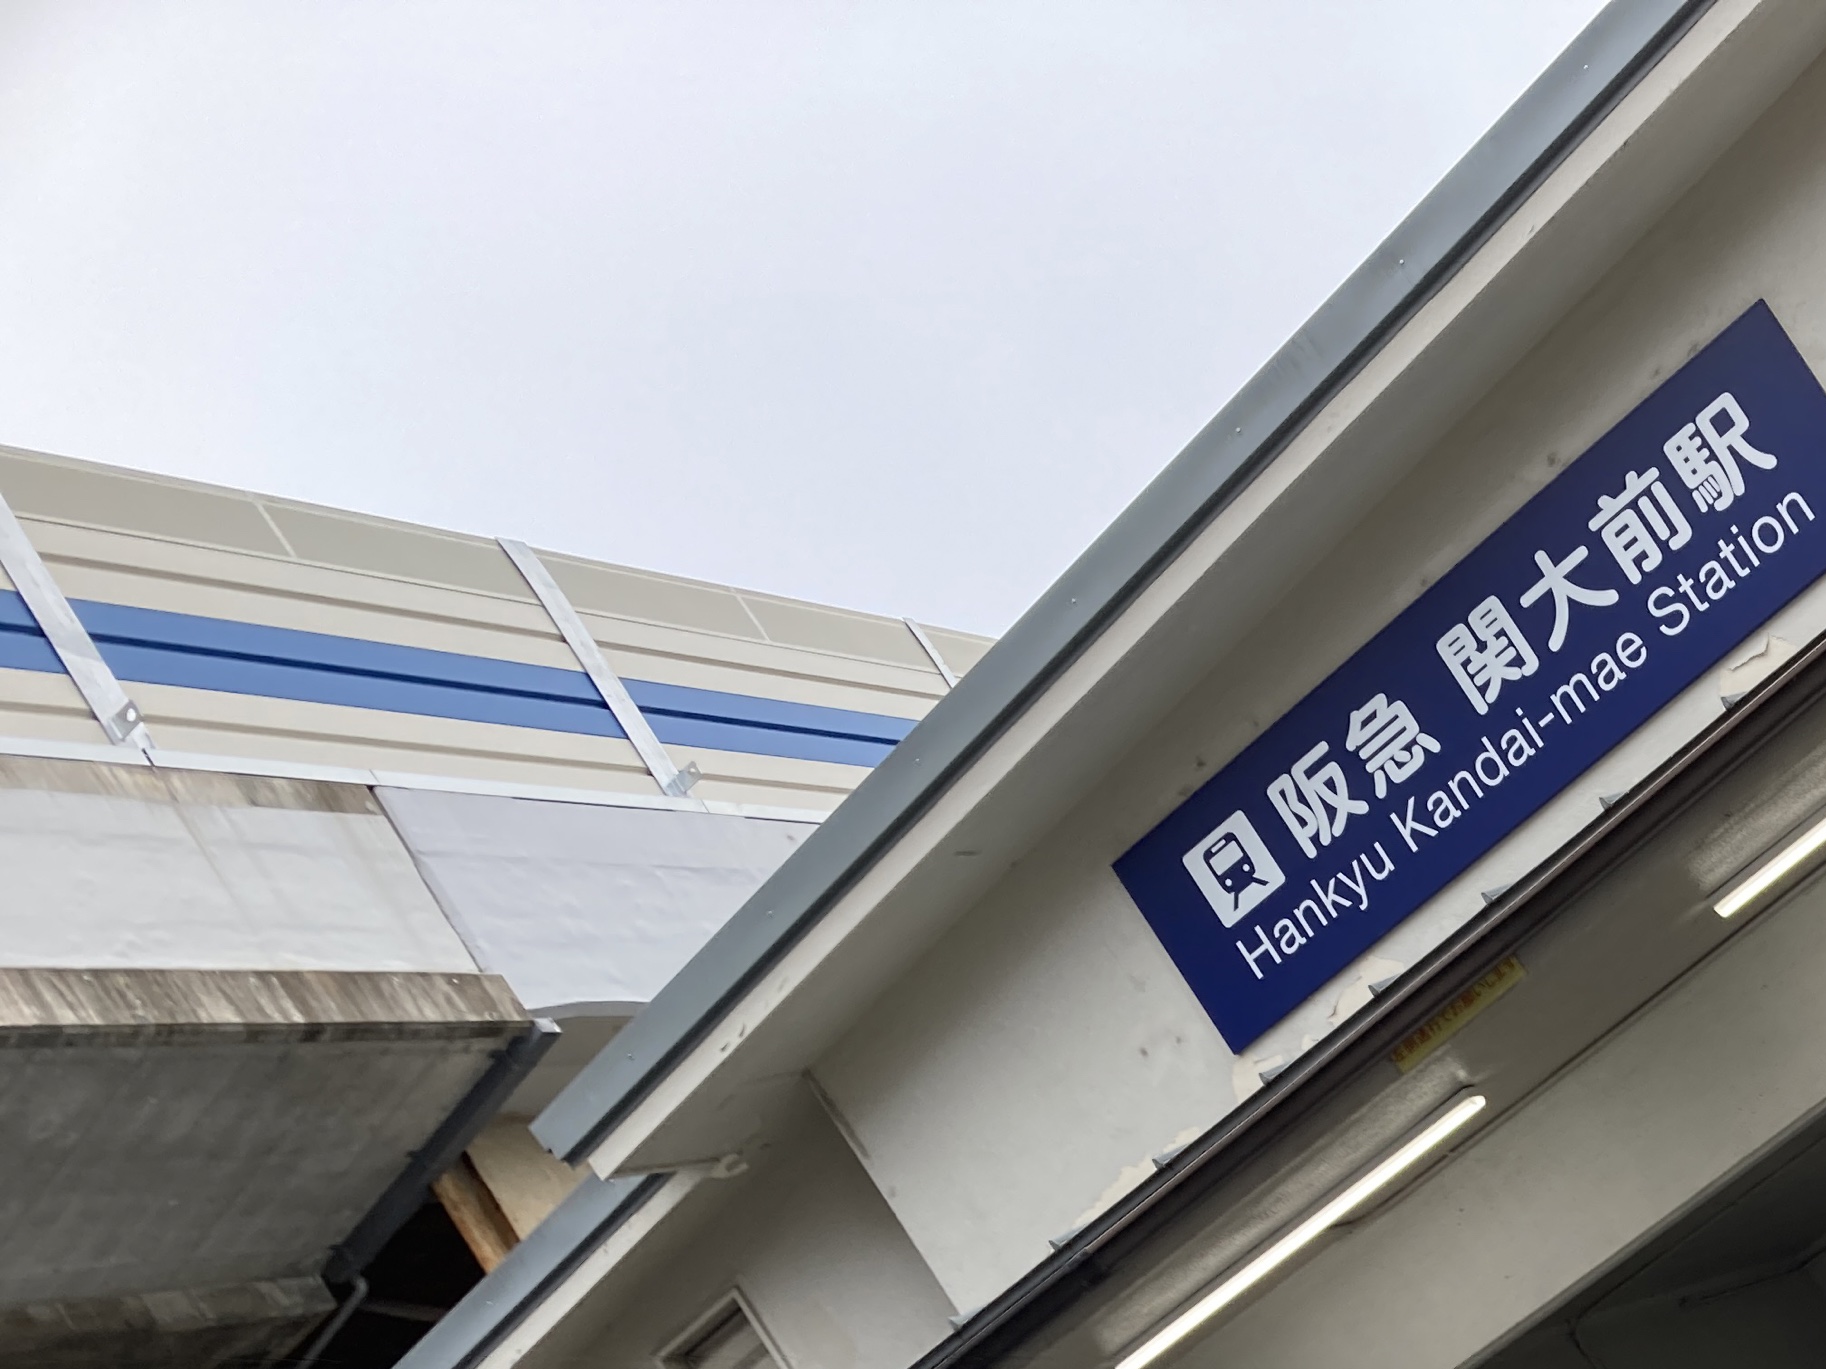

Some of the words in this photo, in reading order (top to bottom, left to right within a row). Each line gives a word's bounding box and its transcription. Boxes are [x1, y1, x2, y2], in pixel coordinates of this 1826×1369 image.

[1236, 839, 1396, 979] Hankyu
[1391, 630, 1648, 853] Kandai-mae
[1646, 491, 1815, 635] Station
[1267, 693, 1440, 859] 阪急
[1437, 392, 1777, 716] 関大前駅
